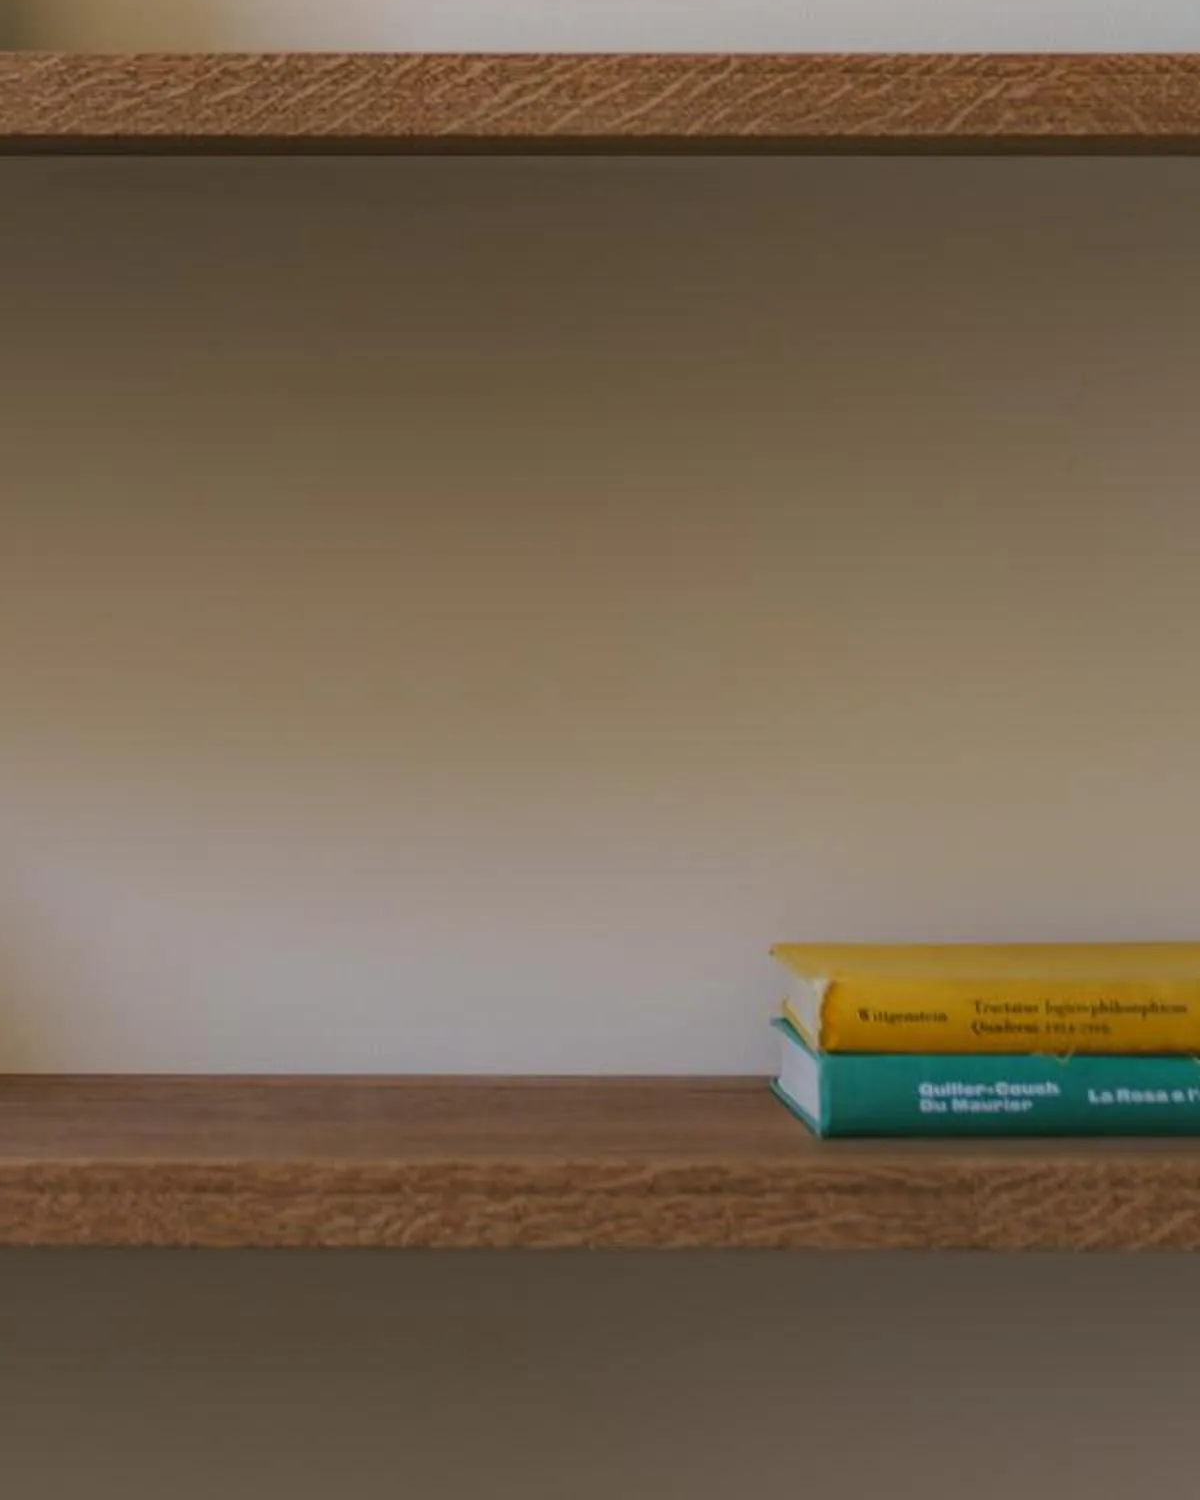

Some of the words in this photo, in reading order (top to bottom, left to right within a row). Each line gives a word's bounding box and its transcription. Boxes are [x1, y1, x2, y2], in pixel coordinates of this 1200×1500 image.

[974, 1000, 1039, 1015] Tractatus
[857, 1008, 949, 1025] Wittgenstein
[918, 1081, 1061, 1098] Quiller-Couch
[1087, 1087, 1114, 1104] La
[1115, 1087, 1169, 1104] Rosa
[1171, 1088, 1185, 1103] e
[919, 1098, 948, 1112] Du
[951, 1098, 1033, 1113] Maurier
